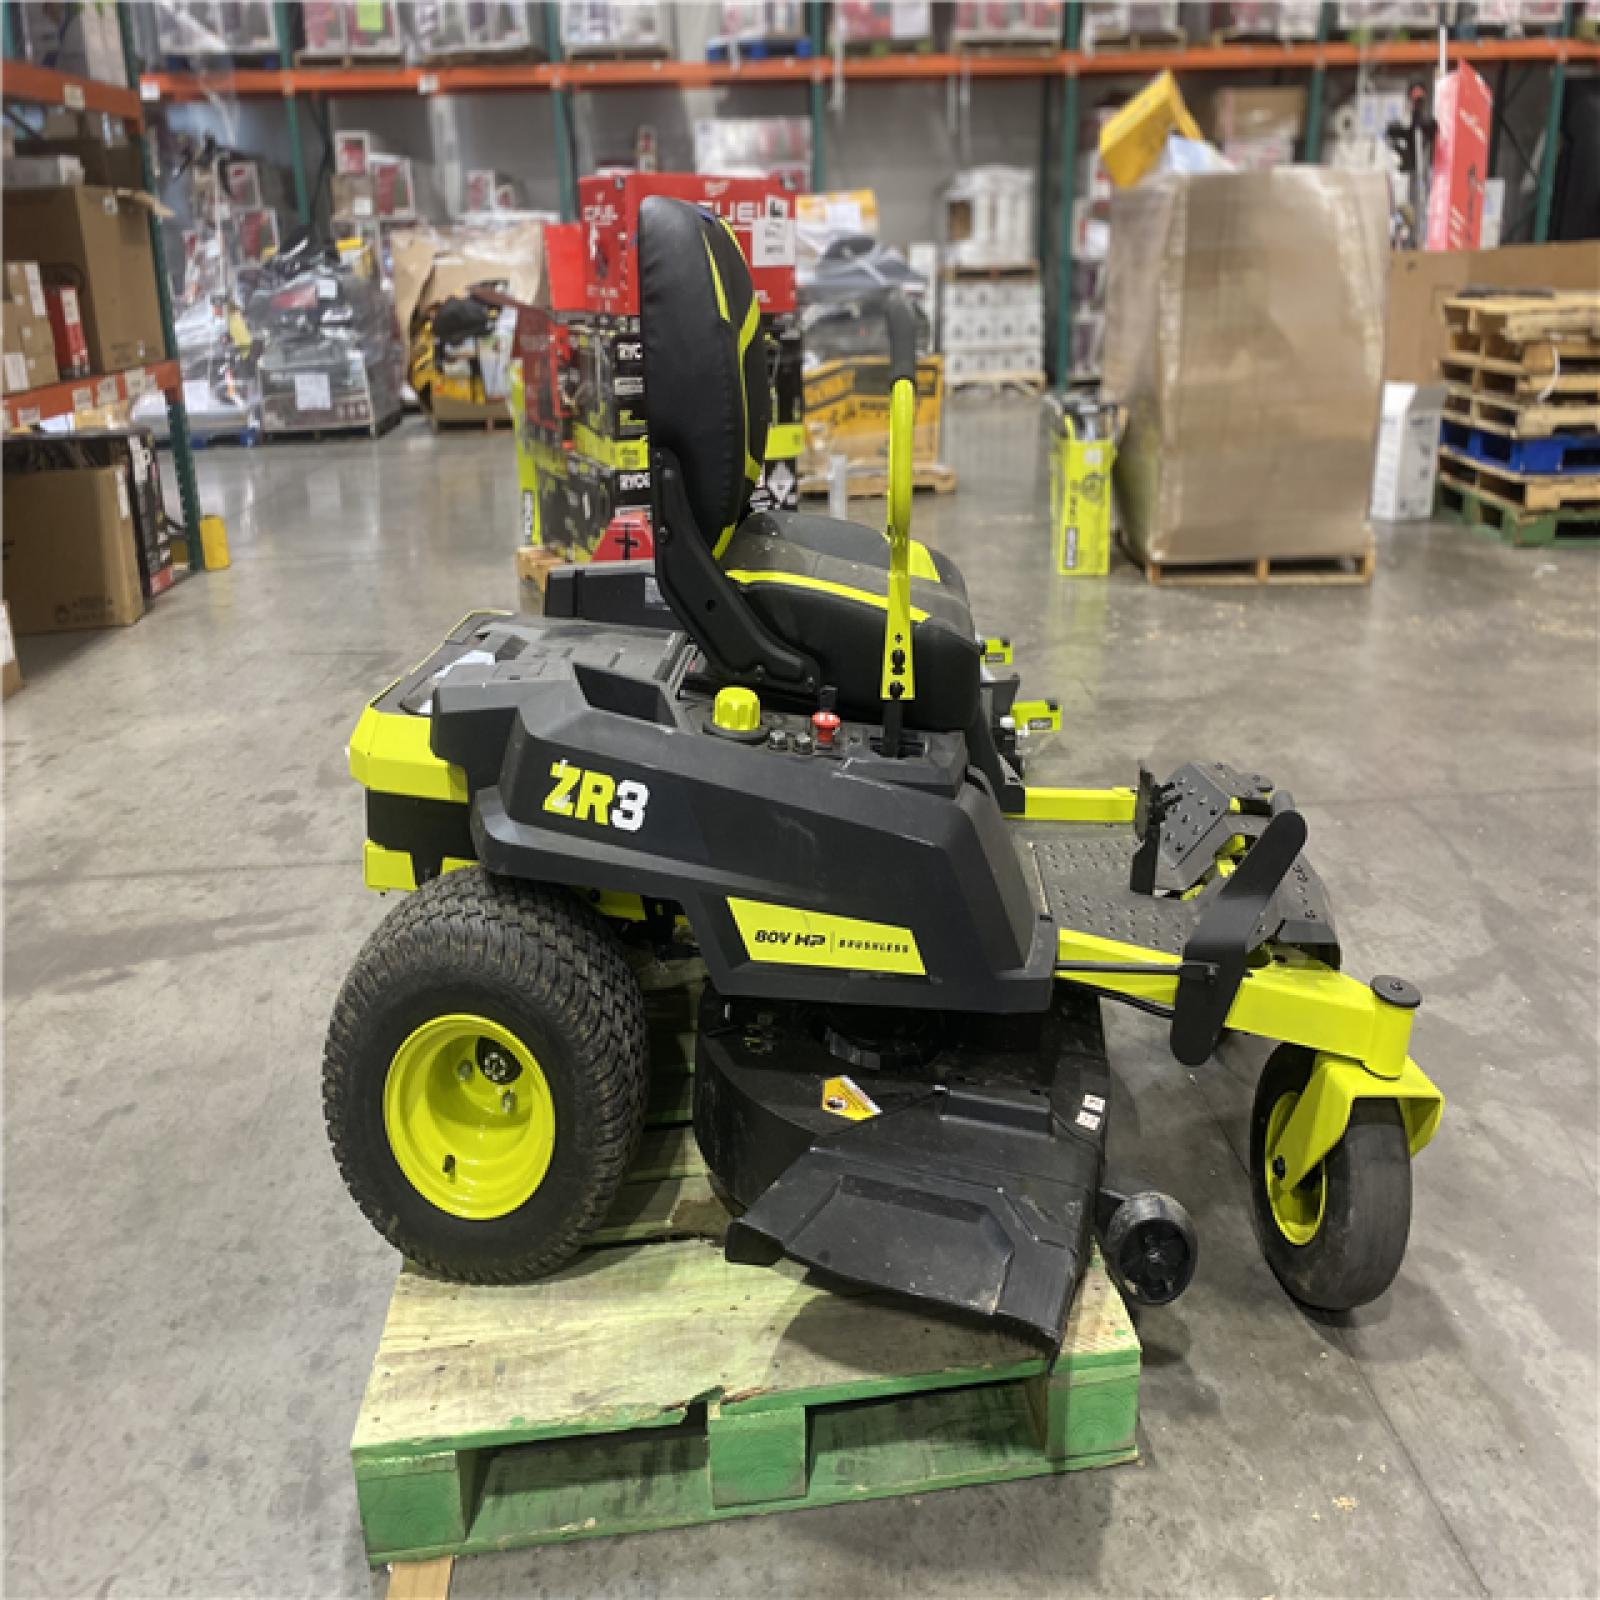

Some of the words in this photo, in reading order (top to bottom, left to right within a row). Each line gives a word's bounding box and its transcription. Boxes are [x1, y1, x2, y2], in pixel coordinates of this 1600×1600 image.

[543, 760, 649, 832] ZR3
[754, 930, 792, 945] 80V
[795, 932, 826, 947] HP
